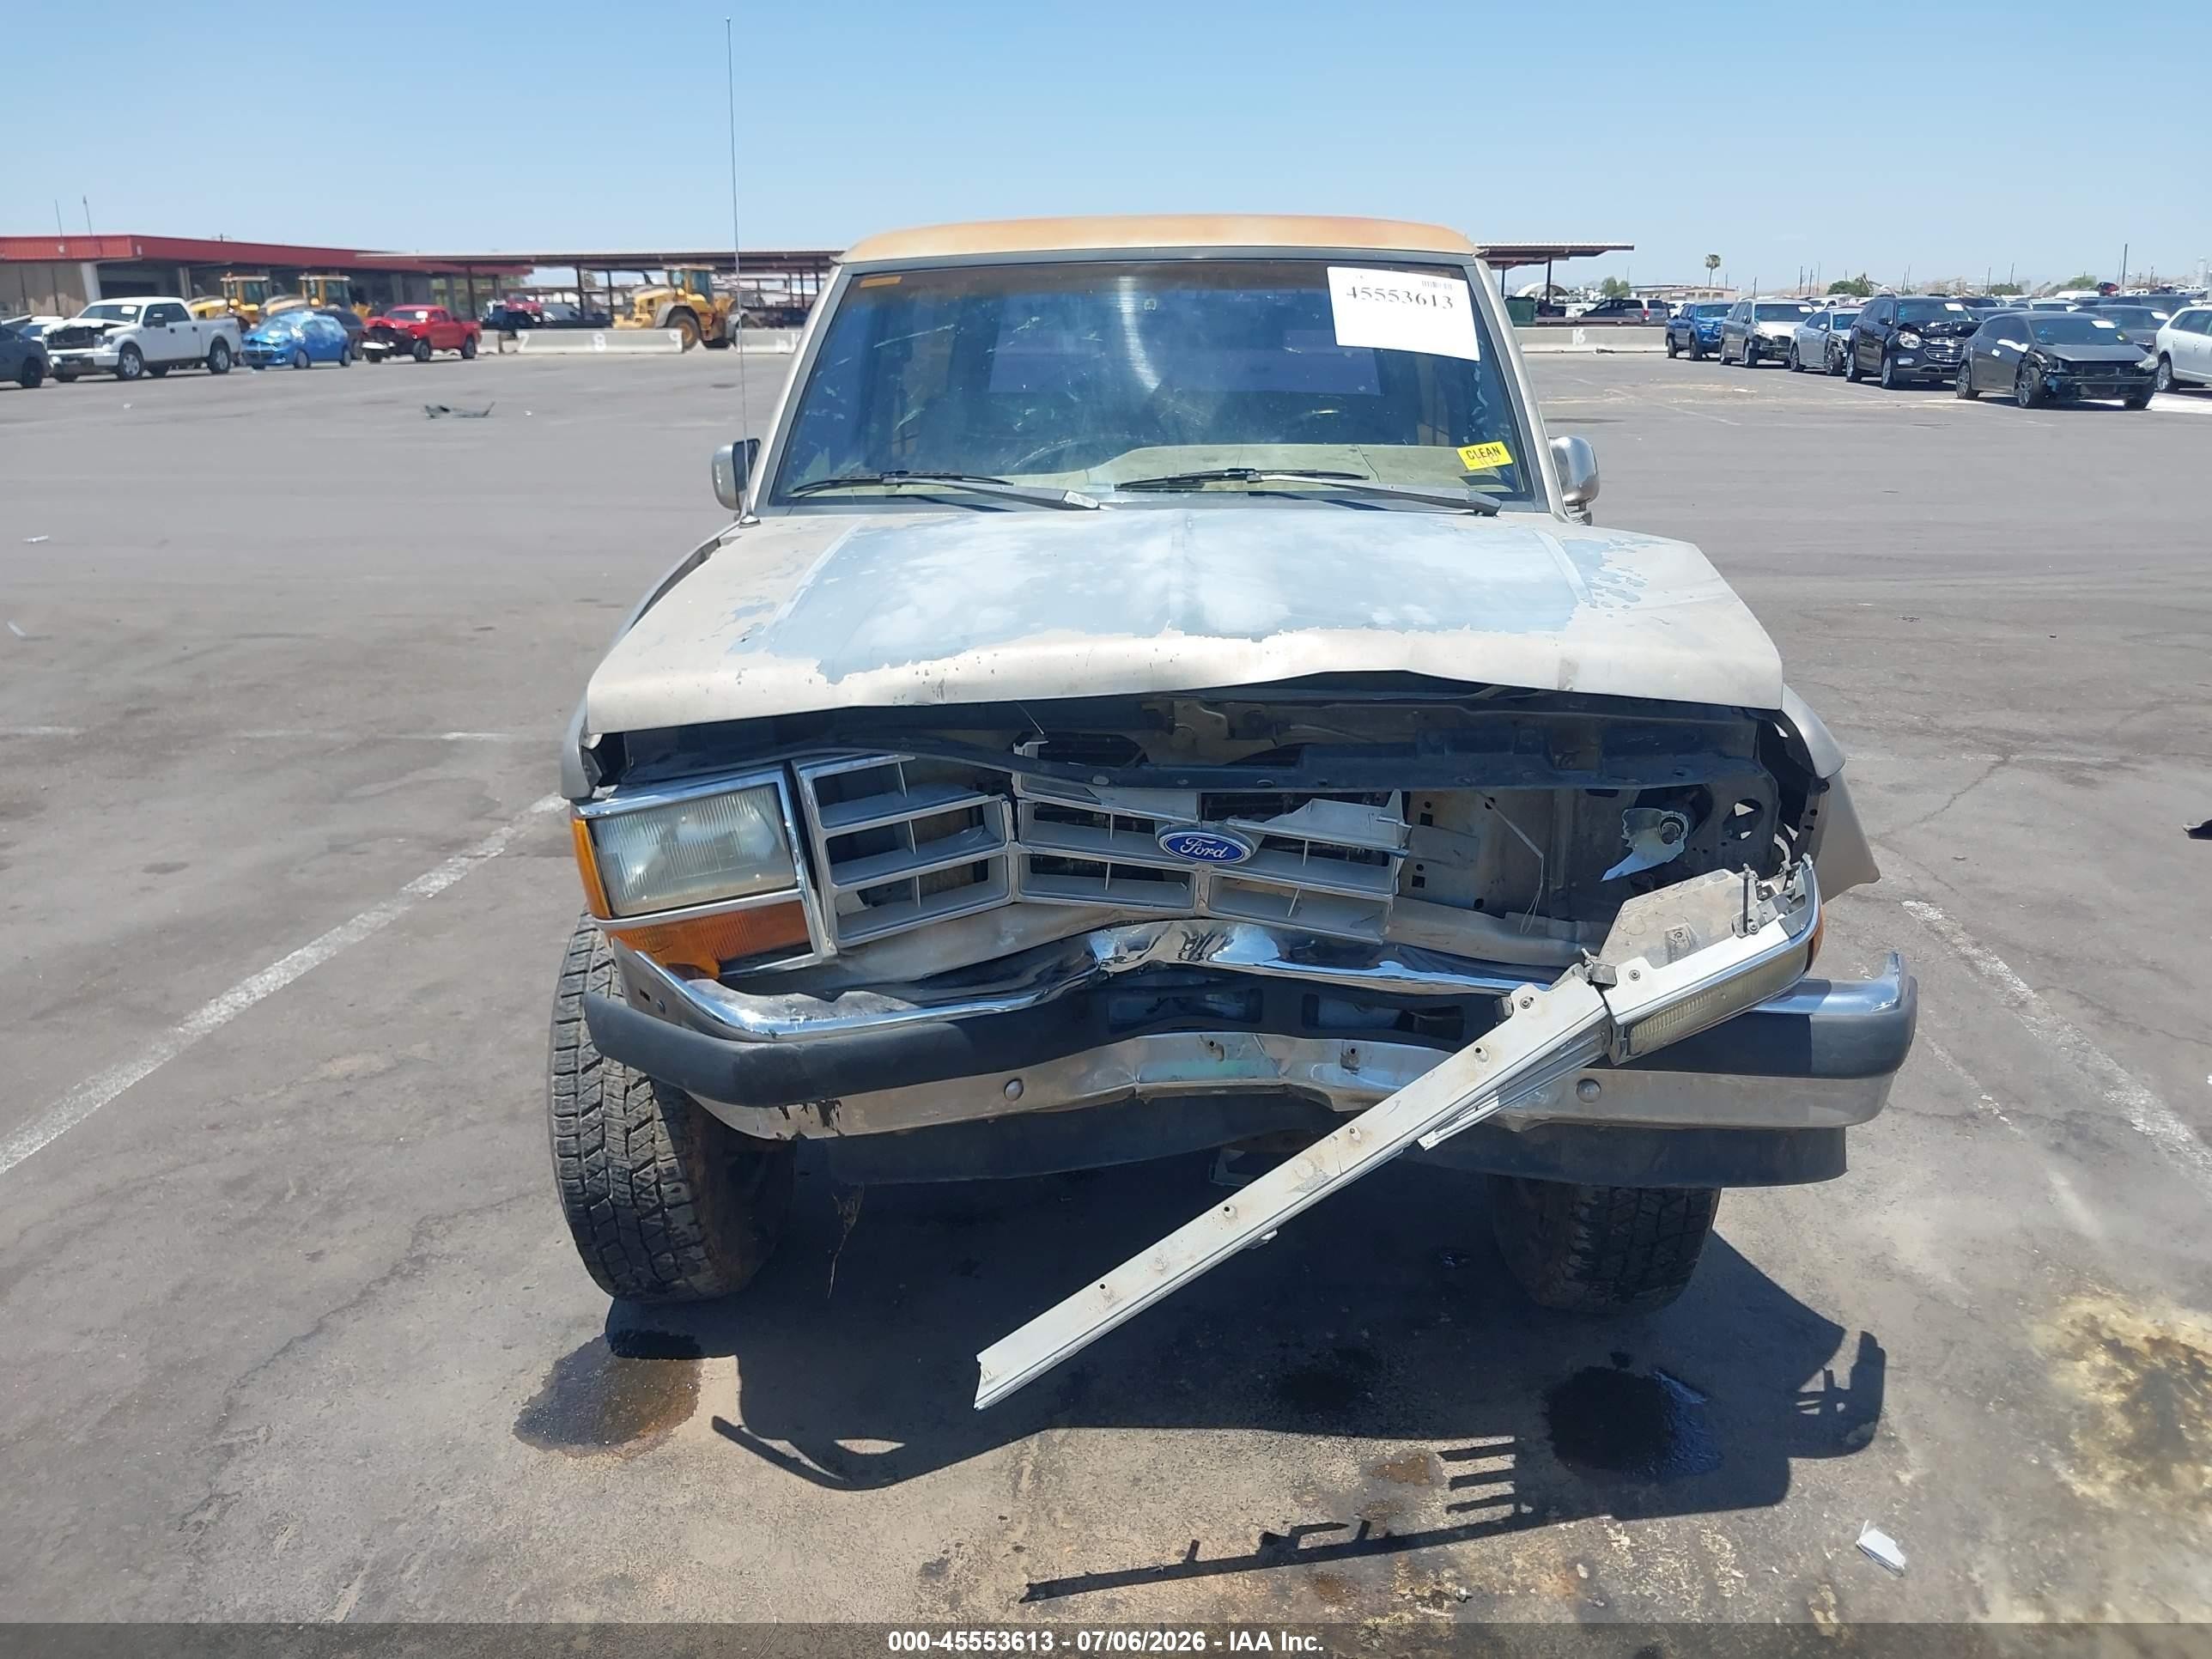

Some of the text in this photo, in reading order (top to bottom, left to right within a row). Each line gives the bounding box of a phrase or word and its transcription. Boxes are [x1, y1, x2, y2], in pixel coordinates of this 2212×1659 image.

[1346, 286, 1454, 309] 45553613
[1465, 446, 1502, 460] CLEAN
[1180, 836, 1227, 859] Ford
